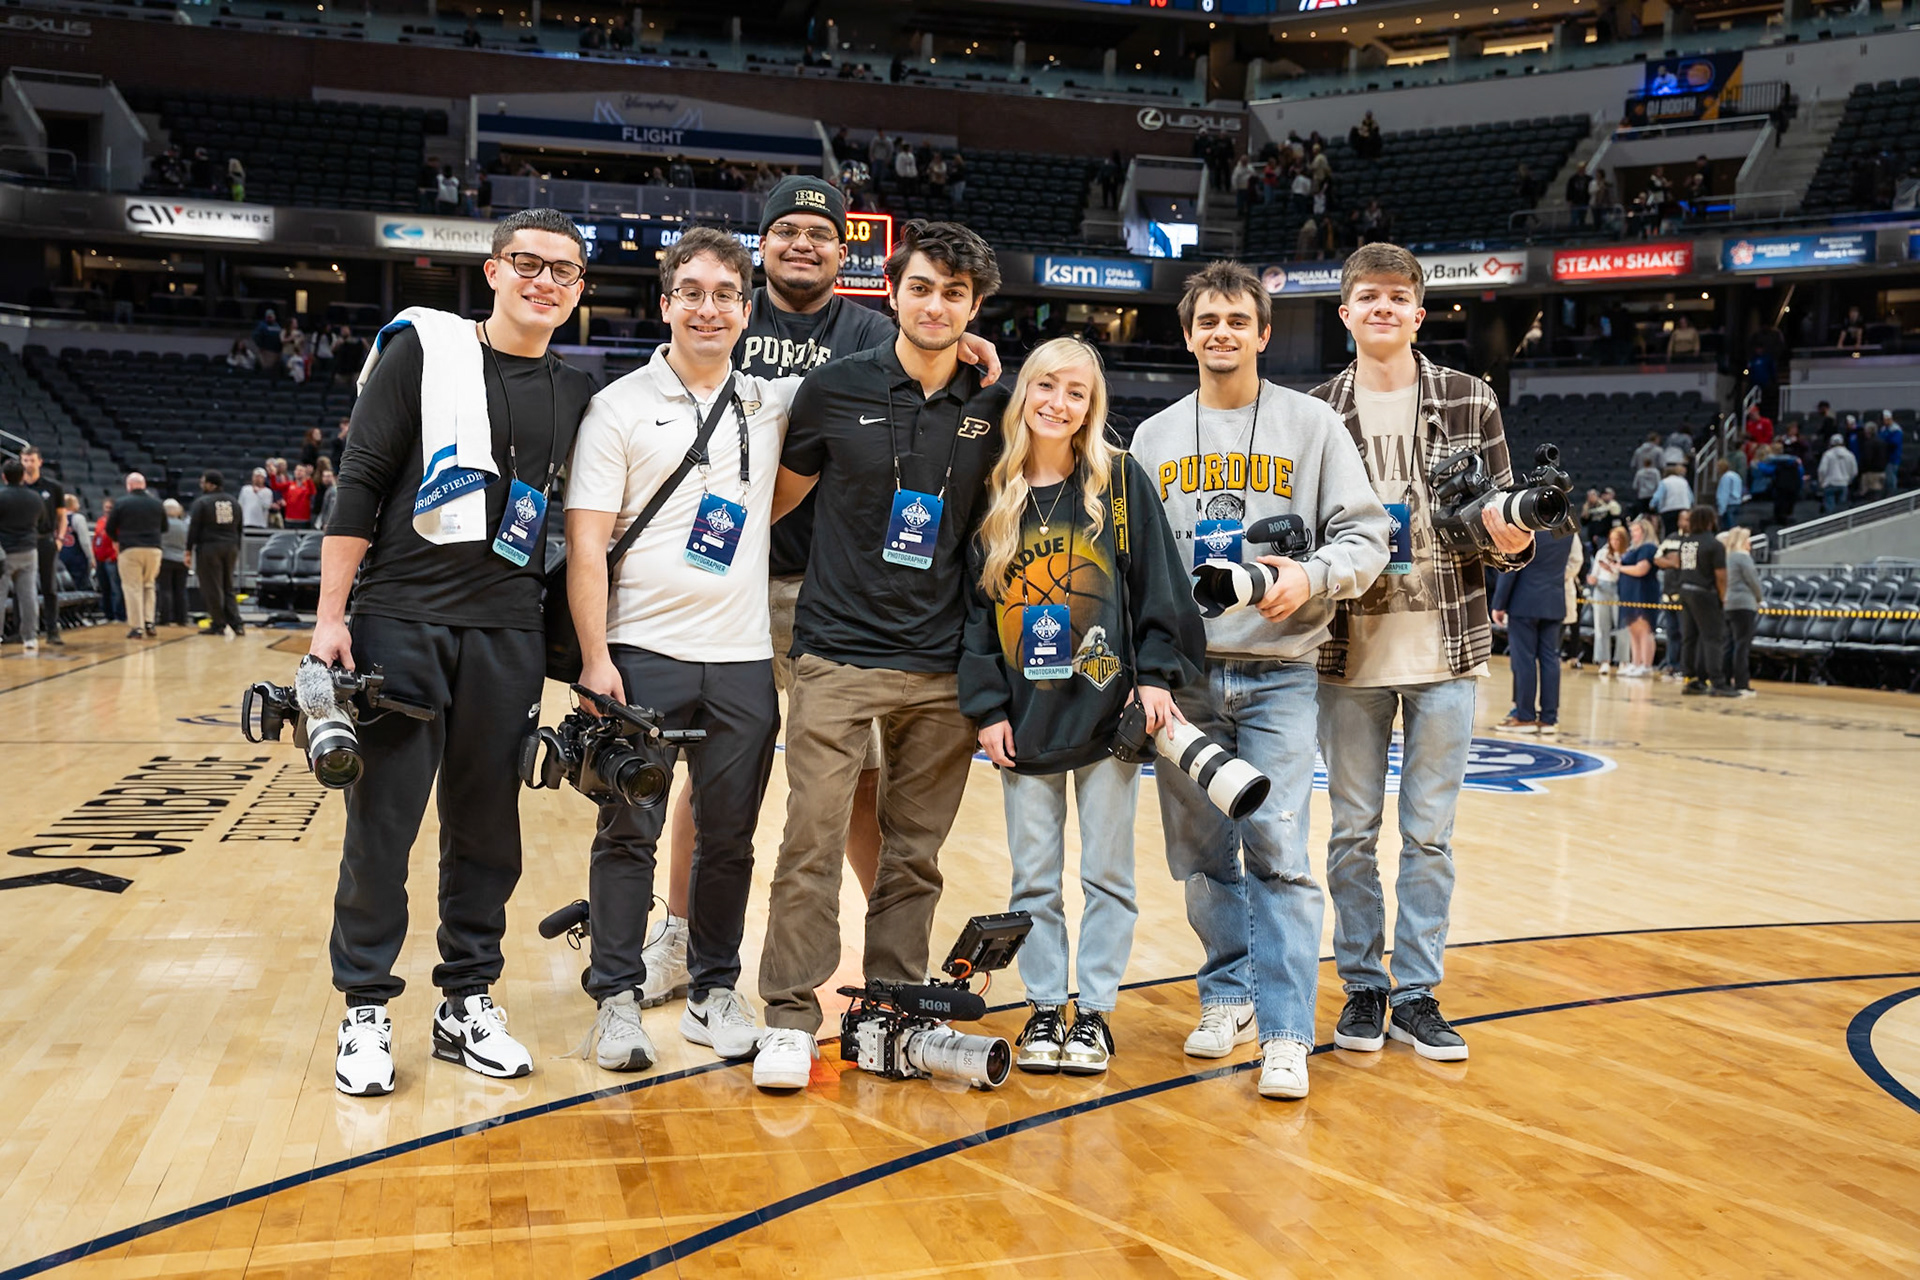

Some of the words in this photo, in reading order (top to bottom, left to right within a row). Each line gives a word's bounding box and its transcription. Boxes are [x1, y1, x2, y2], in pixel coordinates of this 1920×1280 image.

[0, 15, 93, 36] EXUS
[1166, 113, 1242, 131] LEXUS
[622, 127, 684, 144] FLIGHT
[186, 209, 224, 220] CITY
[230, 213, 271, 224] WIDE
[795, 201, 831, 212] NETWORK
[1044, 257, 1098, 285] ksm
[1556, 254, 1612, 274] STEAK
[1625, 249, 1686, 270] SHAKE
[843, 277, 886, 288] TISSOT
[1287, 271, 1330, 282] INDIANA
[1423, 263, 1479, 282] yBank
[1361, 435, 1428, 483] RVAN
[441, 470, 487, 495] FIELDH
[1158, 451, 1295, 503] PURDUE
[1118, 527, 1126, 551] Nikon
[496, 541, 526, 562] PHOTOGRAPHER
[687, 551, 726, 573] PHOTOGRAPHER
[886, 550, 928, 566] PHOTOGRAPHER
[996, 536, 1065, 606] RDUE
[1028, 667, 1069, 676] PHOTOGRAPHER
[1081, 656, 1120, 683] PURDUE
[6, 756, 272, 859] GAINBRIDGE
